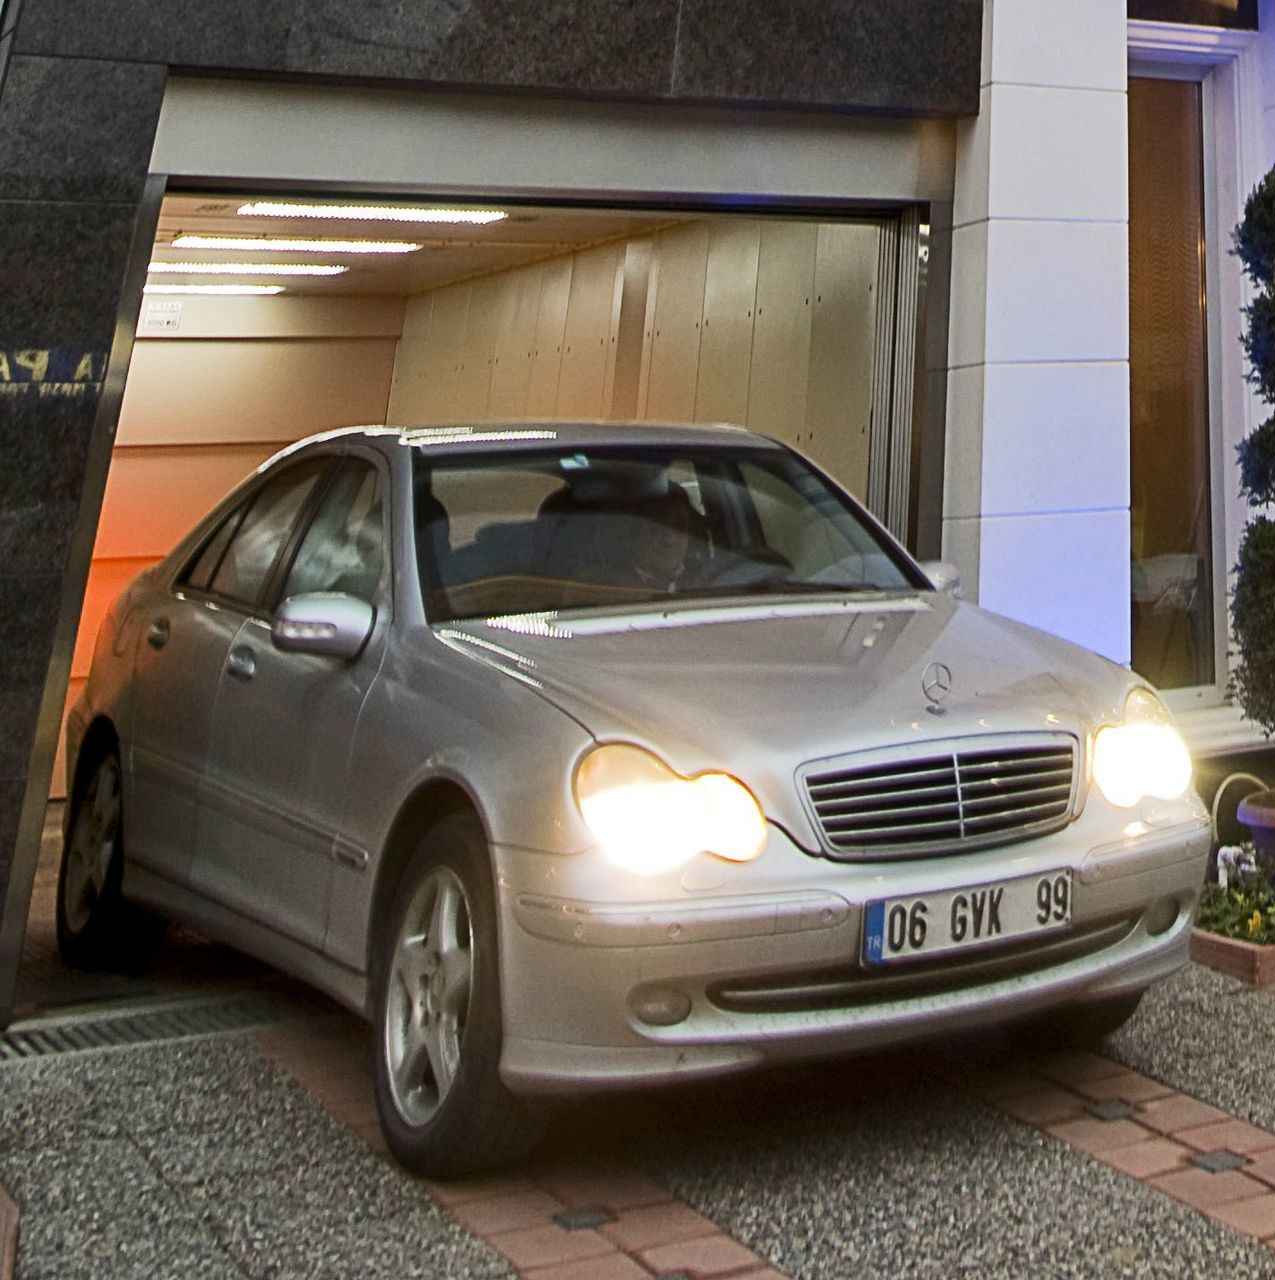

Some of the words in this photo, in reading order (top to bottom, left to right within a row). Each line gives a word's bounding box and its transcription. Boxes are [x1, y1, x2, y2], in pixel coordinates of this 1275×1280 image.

[887, 900, 928, 952] 06
[951, 887, 1004, 942] GVK
[1036, 876, 1069, 925] 99
[866, 934, 881, 951] TR
